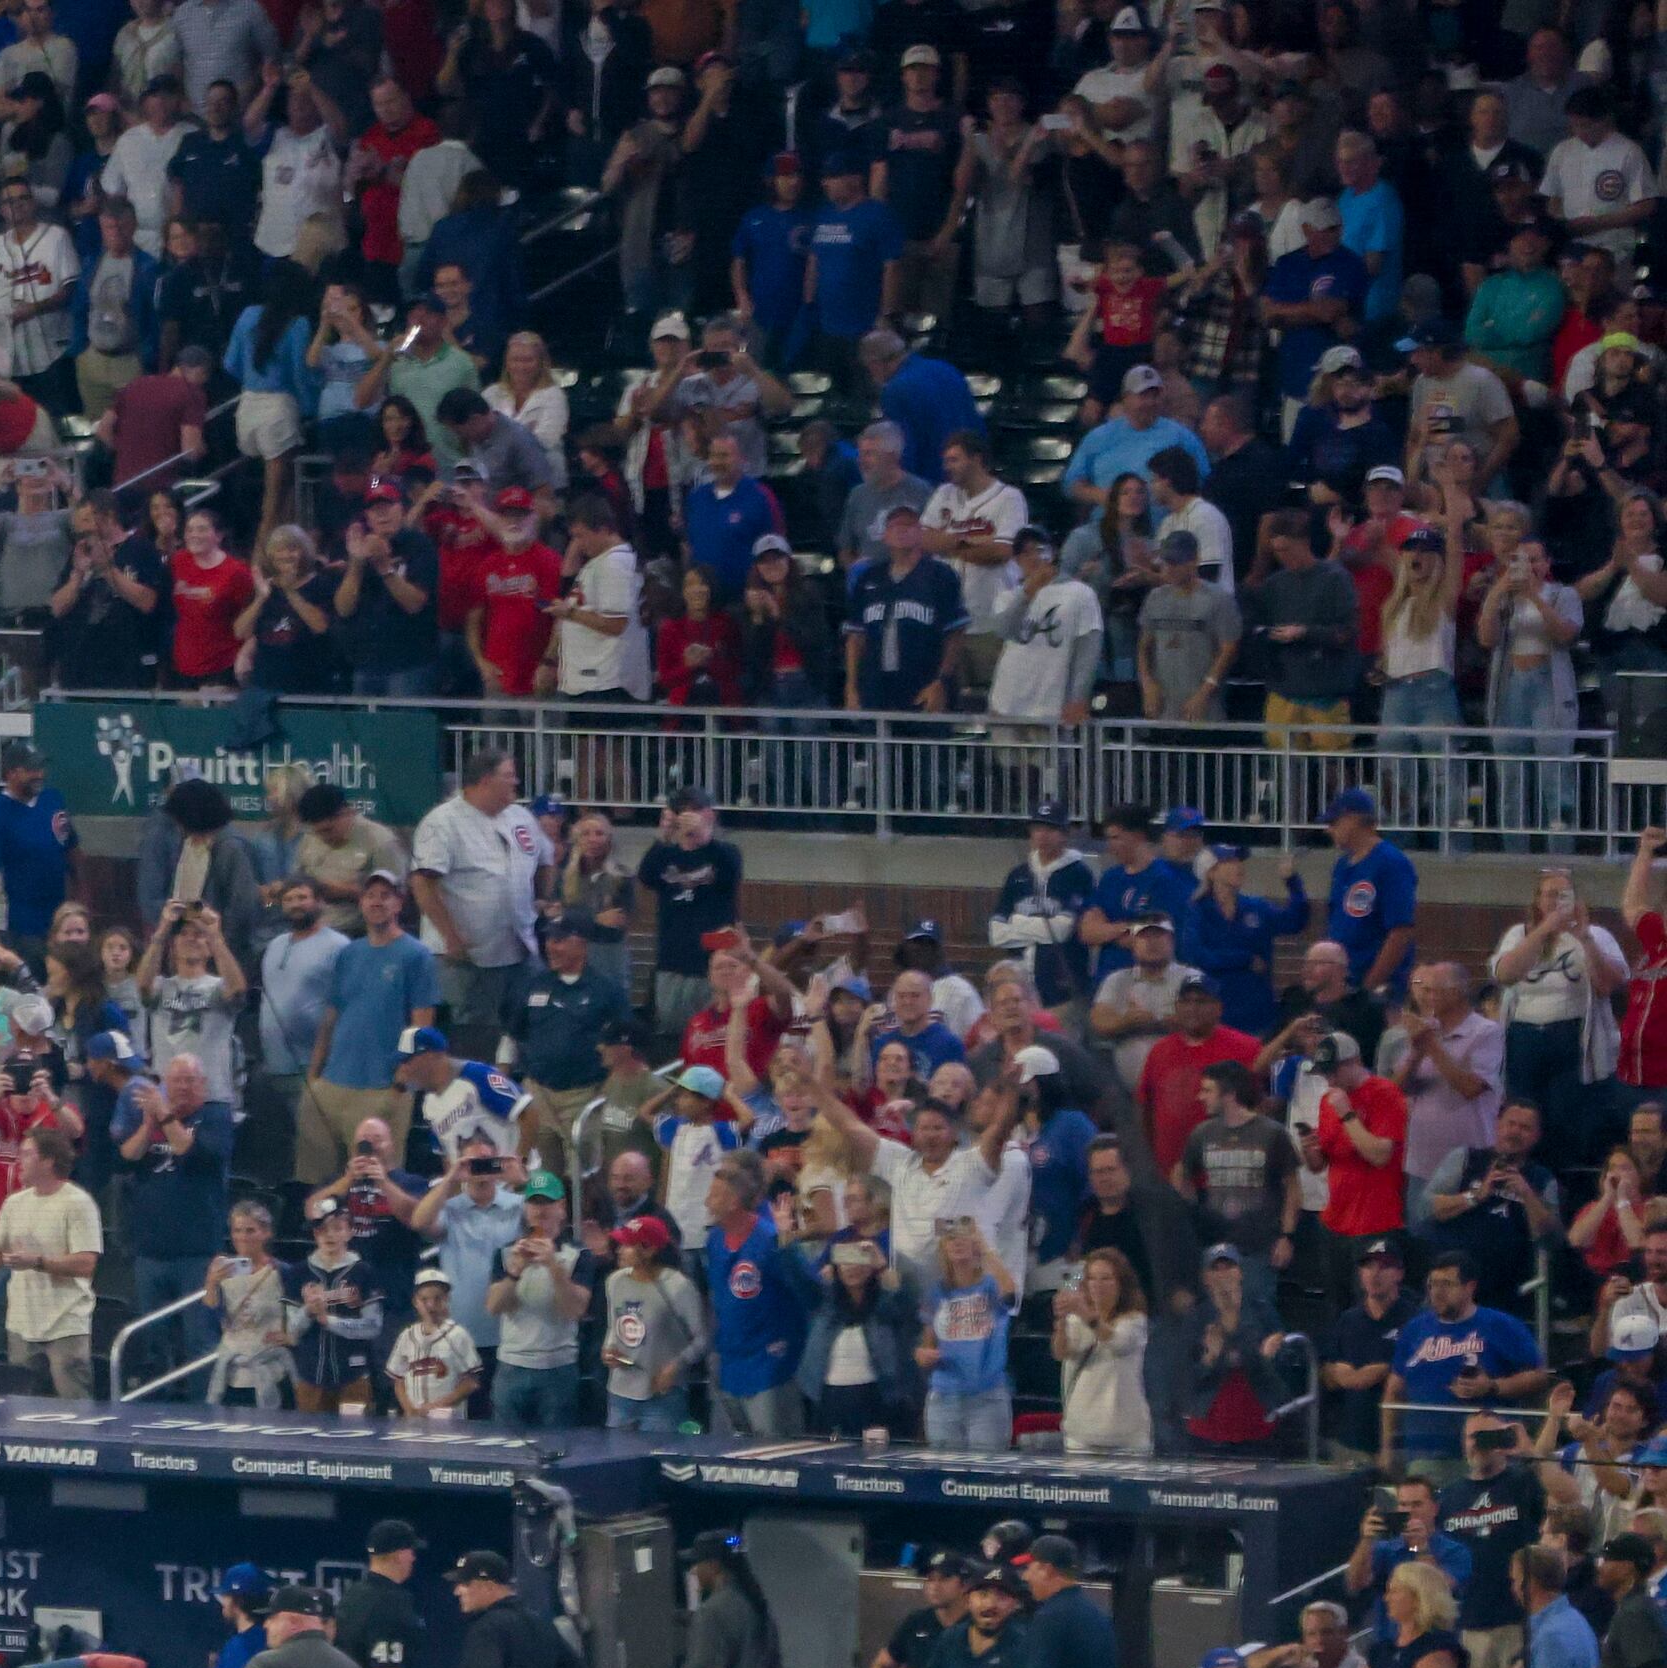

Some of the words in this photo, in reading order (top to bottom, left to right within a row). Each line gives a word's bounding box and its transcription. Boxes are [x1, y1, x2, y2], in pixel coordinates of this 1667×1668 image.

[3, 1443, 99, 1467] YANMAR
[130, 1450, 199, 1473] Tractors
[231, 1456, 305, 1479] Compact
[306, 1459, 394, 1482] Equipment
[427, 1466, 515, 1488] YanmarUS
[698, 1464, 800, 1489] YANMAR
[833, 1473, 905, 1494] Tractors
[941, 1478, 1018, 1500] Compact
[1019, 1481, 1111, 1505] Equipment
[1147, 1487, 1280, 1513] YanmarUS.com
[371, 1640, 405, 1663] 43
